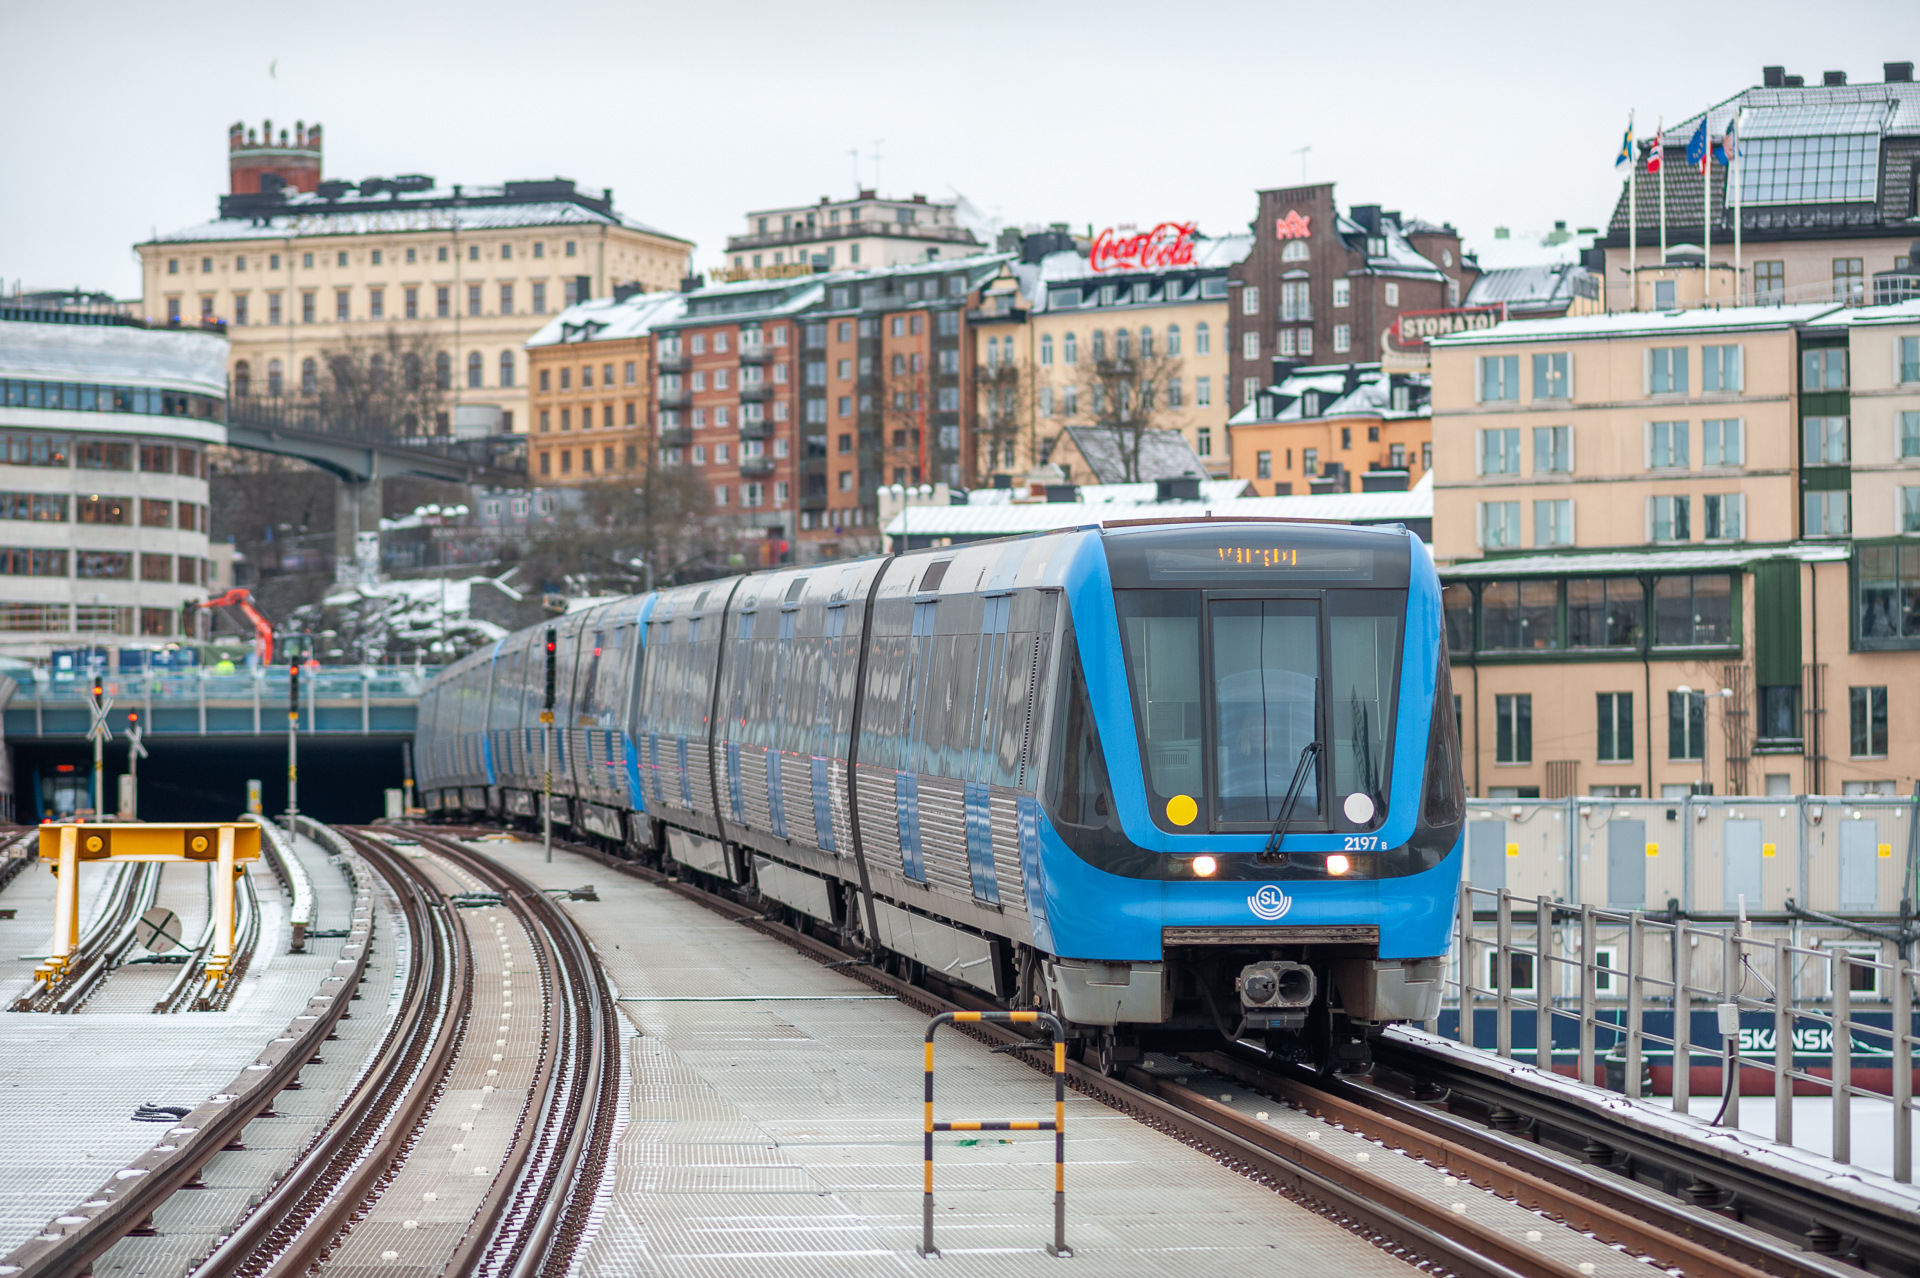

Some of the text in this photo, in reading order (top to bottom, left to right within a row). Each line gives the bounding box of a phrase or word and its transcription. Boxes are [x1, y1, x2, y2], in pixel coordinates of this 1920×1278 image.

[1344, 836, 1388, 851] 2197 B
[1260, 891, 1280, 905] SL
[1738, 1028, 1854, 1050] SKNSK
